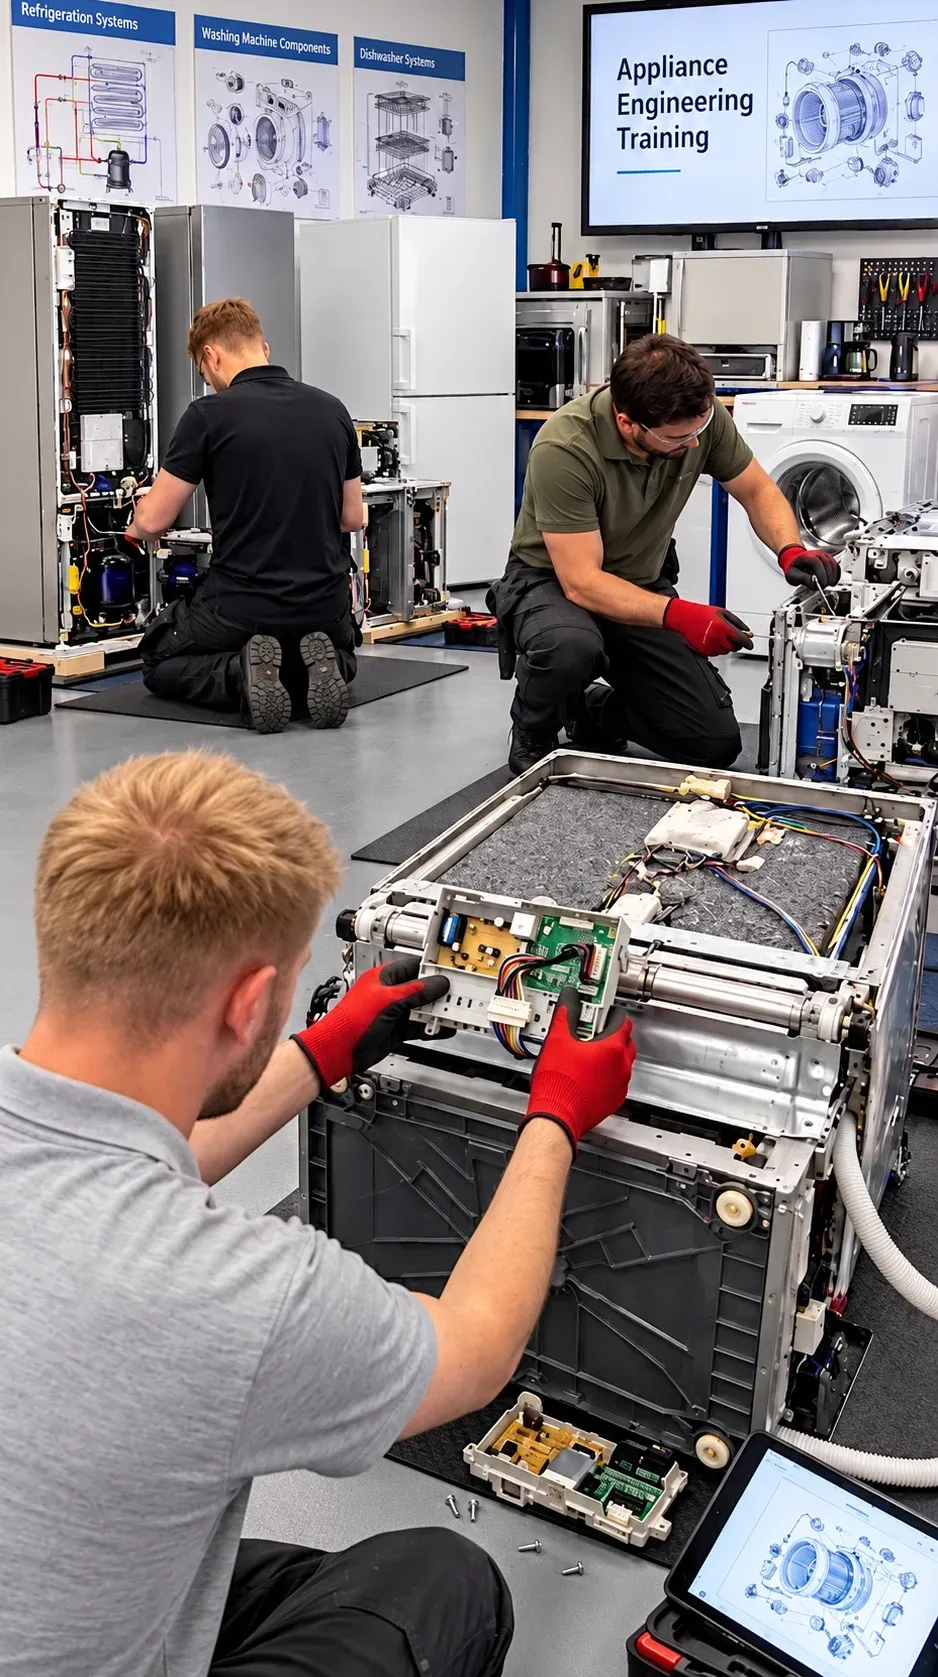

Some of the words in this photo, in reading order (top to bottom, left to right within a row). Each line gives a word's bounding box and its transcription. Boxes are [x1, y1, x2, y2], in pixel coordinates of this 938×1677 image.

[21, 2, 93, 24] Refrigeration
[96, 13, 138, 30] Systems
[201, 27, 239, 46] Washing
[242, 32, 277, 48] Machine
[280, 38, 331, 55] Components
[360, 48, 403, 64] Dishwasher
[405, 54, 435, 68] Systems
[617, 54, 728, 86] Appliance
[618, 87, 753, 120] Engineering
[617, 124, 709, 153] Training
